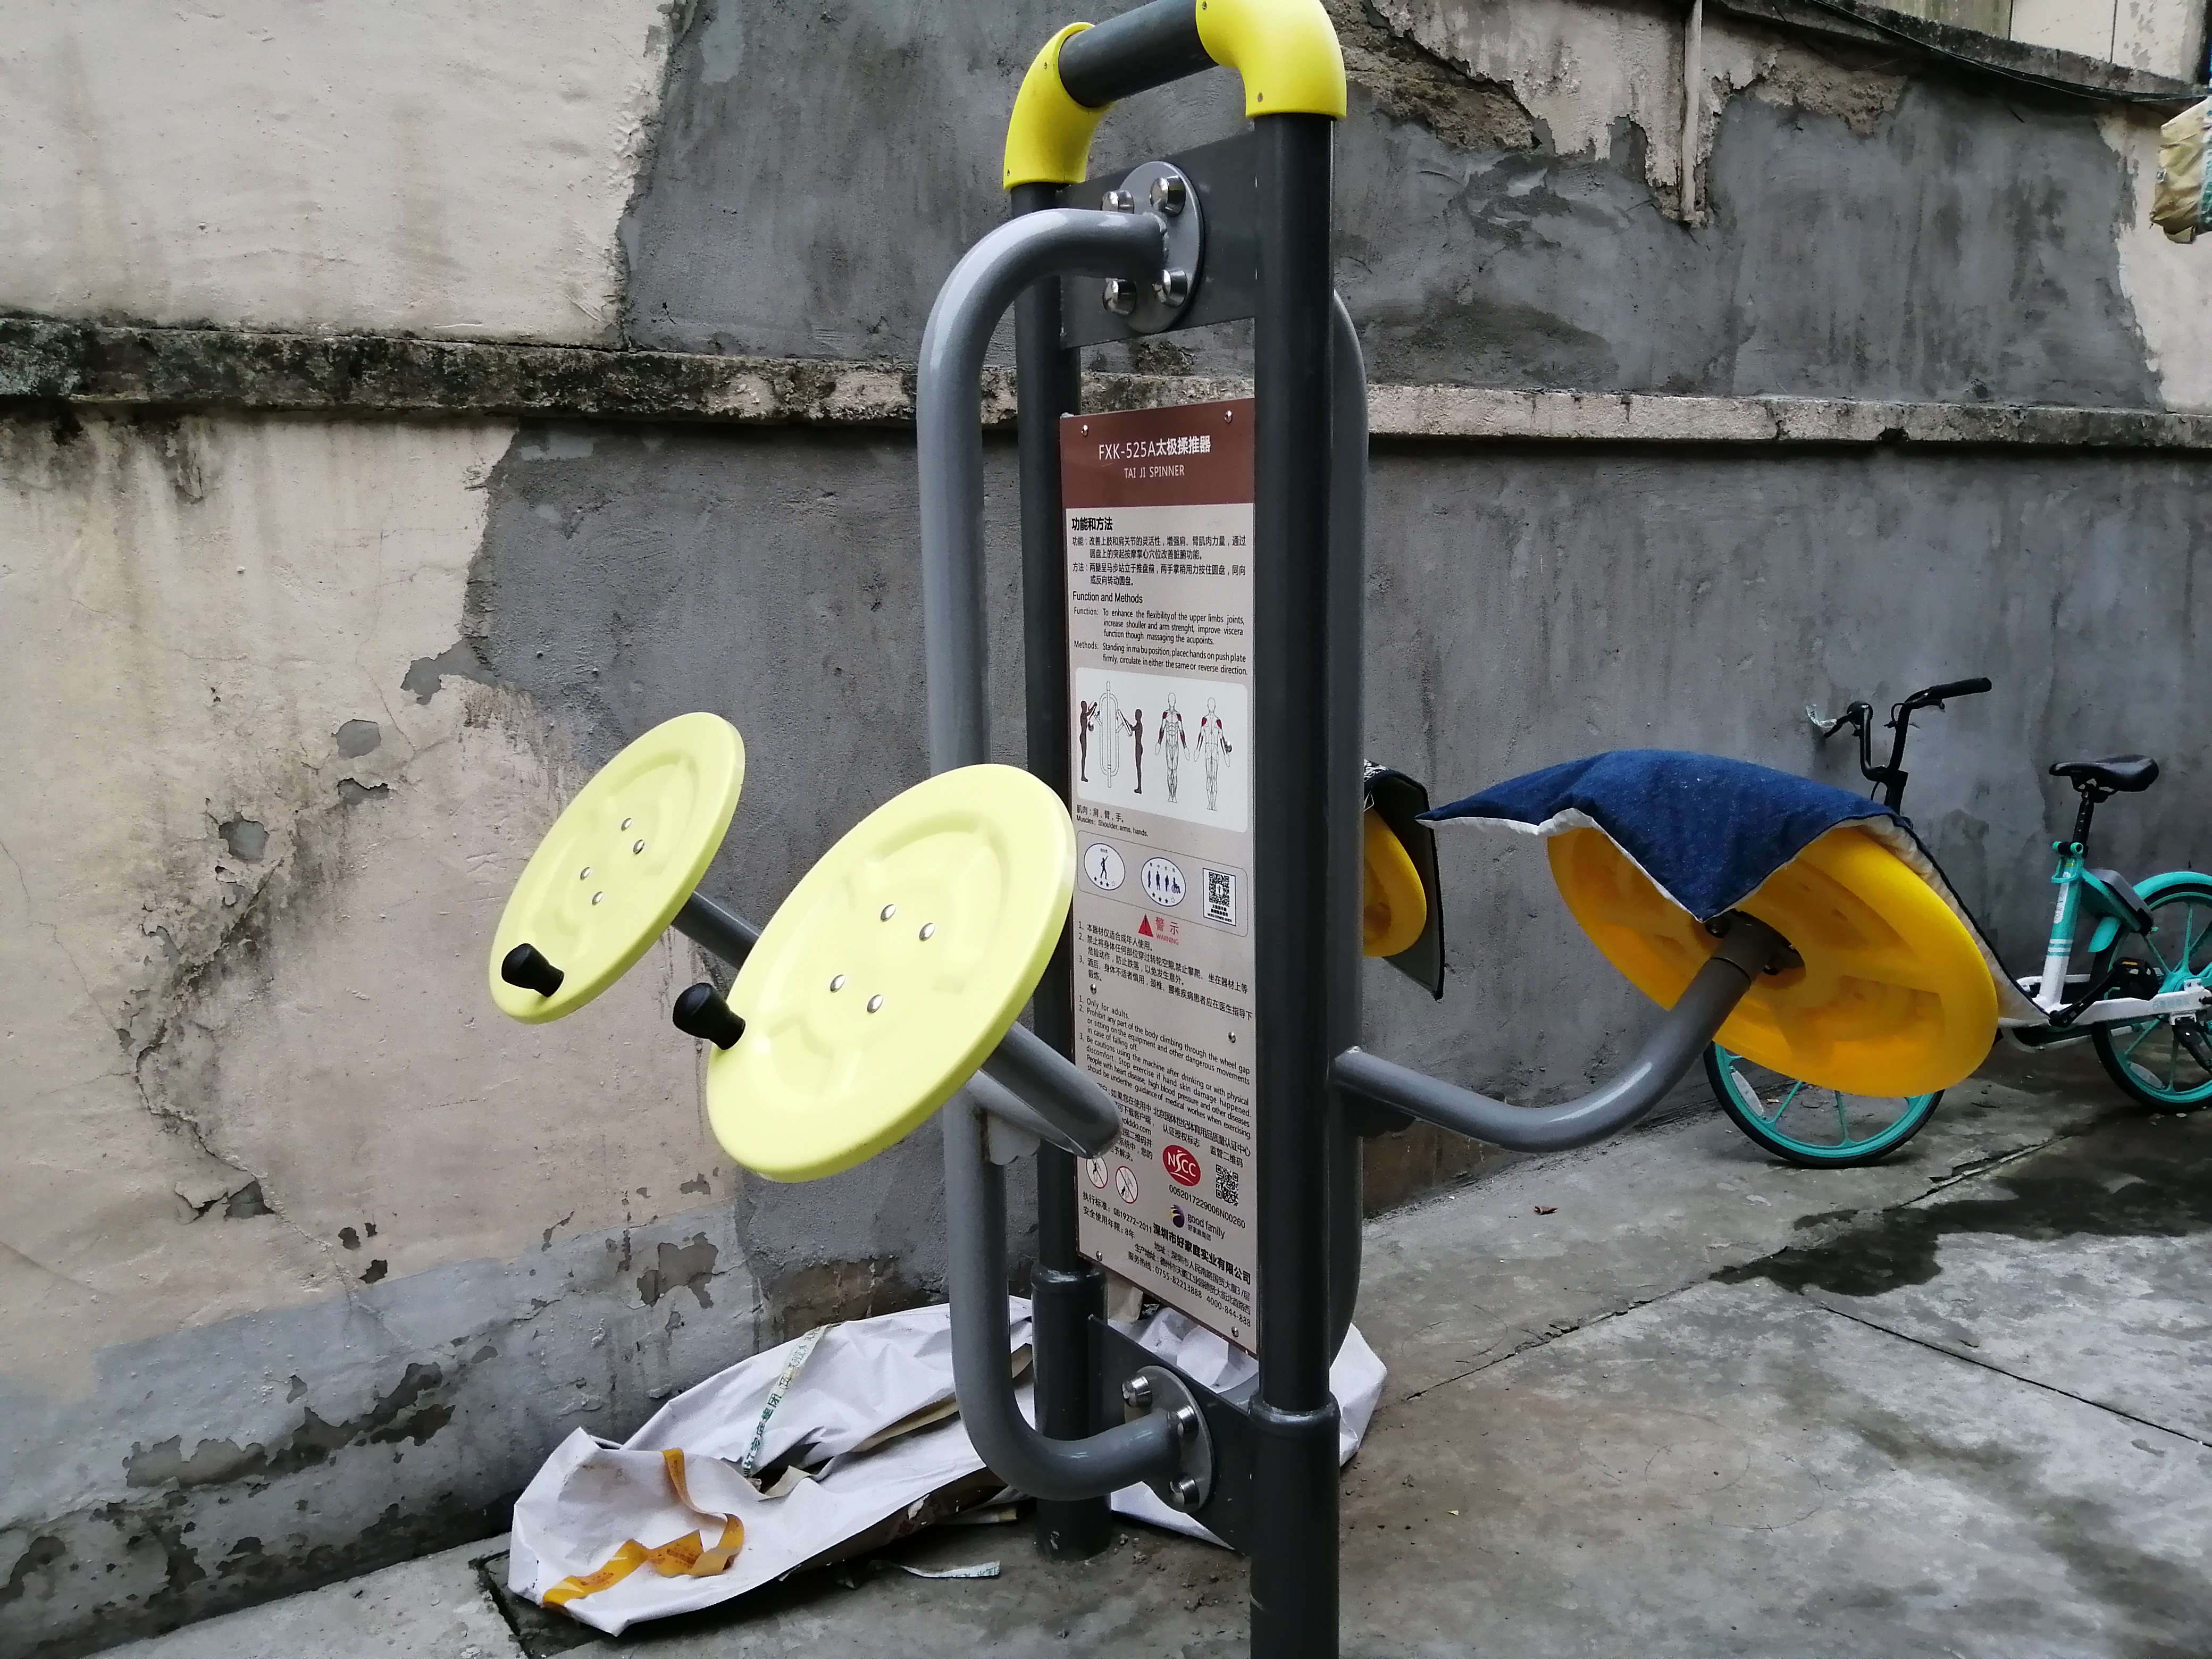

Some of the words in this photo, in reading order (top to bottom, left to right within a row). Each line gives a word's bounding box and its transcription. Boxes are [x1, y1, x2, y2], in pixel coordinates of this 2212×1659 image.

[1125, 467, 1136, 479] TAI
[1139, 467, 1146, 478] JI
[1150, 465, 1185, 477] SPINNER
[1072, 517, 1112, 531] 功能和方法
[1090, 575, 1133, 585] 或反向转动圆盘。
[1073, 591, 1099, 601] Function
[1101, 593, 1112, 601] and
[1115, 593, 1143, 604] Methods
[1074, 607, 1099, 615] Function:
[1146, 609, 1170, 622] flexibility
[1189, 615, 1206, 623] upper
[1208, 614, 1224, 622] limbs
[1227, 615, 1244, 625] joints,
[1104, 618, 1123, 627] increase
[1198, 625, 1220, 635] improve
[1224, 627, 1243, 635] viscera
[1104, 629, 1124, 638] function
[1126, 631, 1144, 641] though
[1146, 633, 1174, 643] massaging
[1186, 636, 1214, 646] acupoints.
[1103, 642, 1125, 653] Standing
[1148, 647, 1171, 657] position,
[1190, 649, 1206, 659] hands
[1216, 652, 1229, 661] push
[1230, 653, 1246, 663] plate
[1103, 654, 1118, 664] firmly,
[1120, 656, 1141, 665] circulate
[1220, 665, 1248, 675] direction.
[1157, 933, 1179, 945] WARNING
[1088, 969, 1102, 981] 锻炼。
[1087, 998, 1099, 1009] Only
[1111, 1008, 1129, 1019] adults.
[1087, 1007, 1105, 1020] Prohibit
[1117, 1020, 1127, 1028] part
[1145, 1028, 1158, 1042] body
[1160, 1034, 1183, 1051] climbing
[1185, 1044, 1206, 1058] through
[1209, 1053, 1218, 1062] the
[1220, 1058, 1236, 1069] wheel
[1238, 1065, 1250, 1076] gap
[1094, 1029, 1104, 1038] case
[1113, 1036, 1128, 1049] falling
[1094, 1020, 1109, 1033] sitting
[1118, 1029, 1126, 1037] the
[1128, 1033, 1155, 1049] equipment
[1157, 1044, 1167, 1053] and
[1169, 1049, 1184, 1059] other
[1186, 1054, 1214, 1071] dangerous
[1217, 1067, 1250, 1085] movements
[1095, 1040, 1115, 1052] cautions
[1117, 1049, 1130, 1060] using
[1143, 1059, 1164, 1072] machine
[1167, 1067, 1179, 1078] after
[1182, 1073, 1204, 1090] drinking
[1213, 1087, 1225, 1096] with
[1227, 1092, 1249, 1105] physical
[1087, 1054, 1102, 1066] People
[1103, 1062, 1113, 1070] with
[1115, 1065, 1126, 1076] heart
[1149, 1079, 1159, 1090] high
[1161, 1084, 1175, 1096] blood
[1178, 1093, 1199, 1106] pressure
[1201, 1102, 1210, 1110] and
[1212, 1107, 1226, 1117] other
[1228, 1113, 1250, 1128] diseases
[1118, 1057, 1130, 1069] Stop
[1133, 1065, 1154, 1077] exercise
[1163, 1075, 1177, 1087] hand
[1180, 1083, 1191, 1092] skin
[1194, 1088, 1217, 1103] damage
[1220, 1097, 1251, 1117] happened.
[1135, 1084, 1157, 1099] guidance
[1166, 1097, 1184, 1110] medical
[1187, 1107, 1205, 1119] workes
[1207, 1115, 1221, 1126] when
[1224, 1122, 1252, 1140] exercising.
[1122, 1118, 1151, 1135] olddo.com
[1122, 1127, 1153, 1147] 描二维码并
[1163, 1124, 1200, 1147] 认证授权标志
[1168, 1149, 1196, 1177] NSCC
[1210, 1145, 1243, 1168] 监管二维码
[1169, 1185, 1245, 1228] 0052017229006N00260
[1188, 1214, 1204, 1228] good
[1206, 1221, 1225, 1239] family
[1153, 1222, 1251, 1285] 深圳市好家庭实业有限公司
[1206, 1296, 1251, 1327] 4000-844-888
